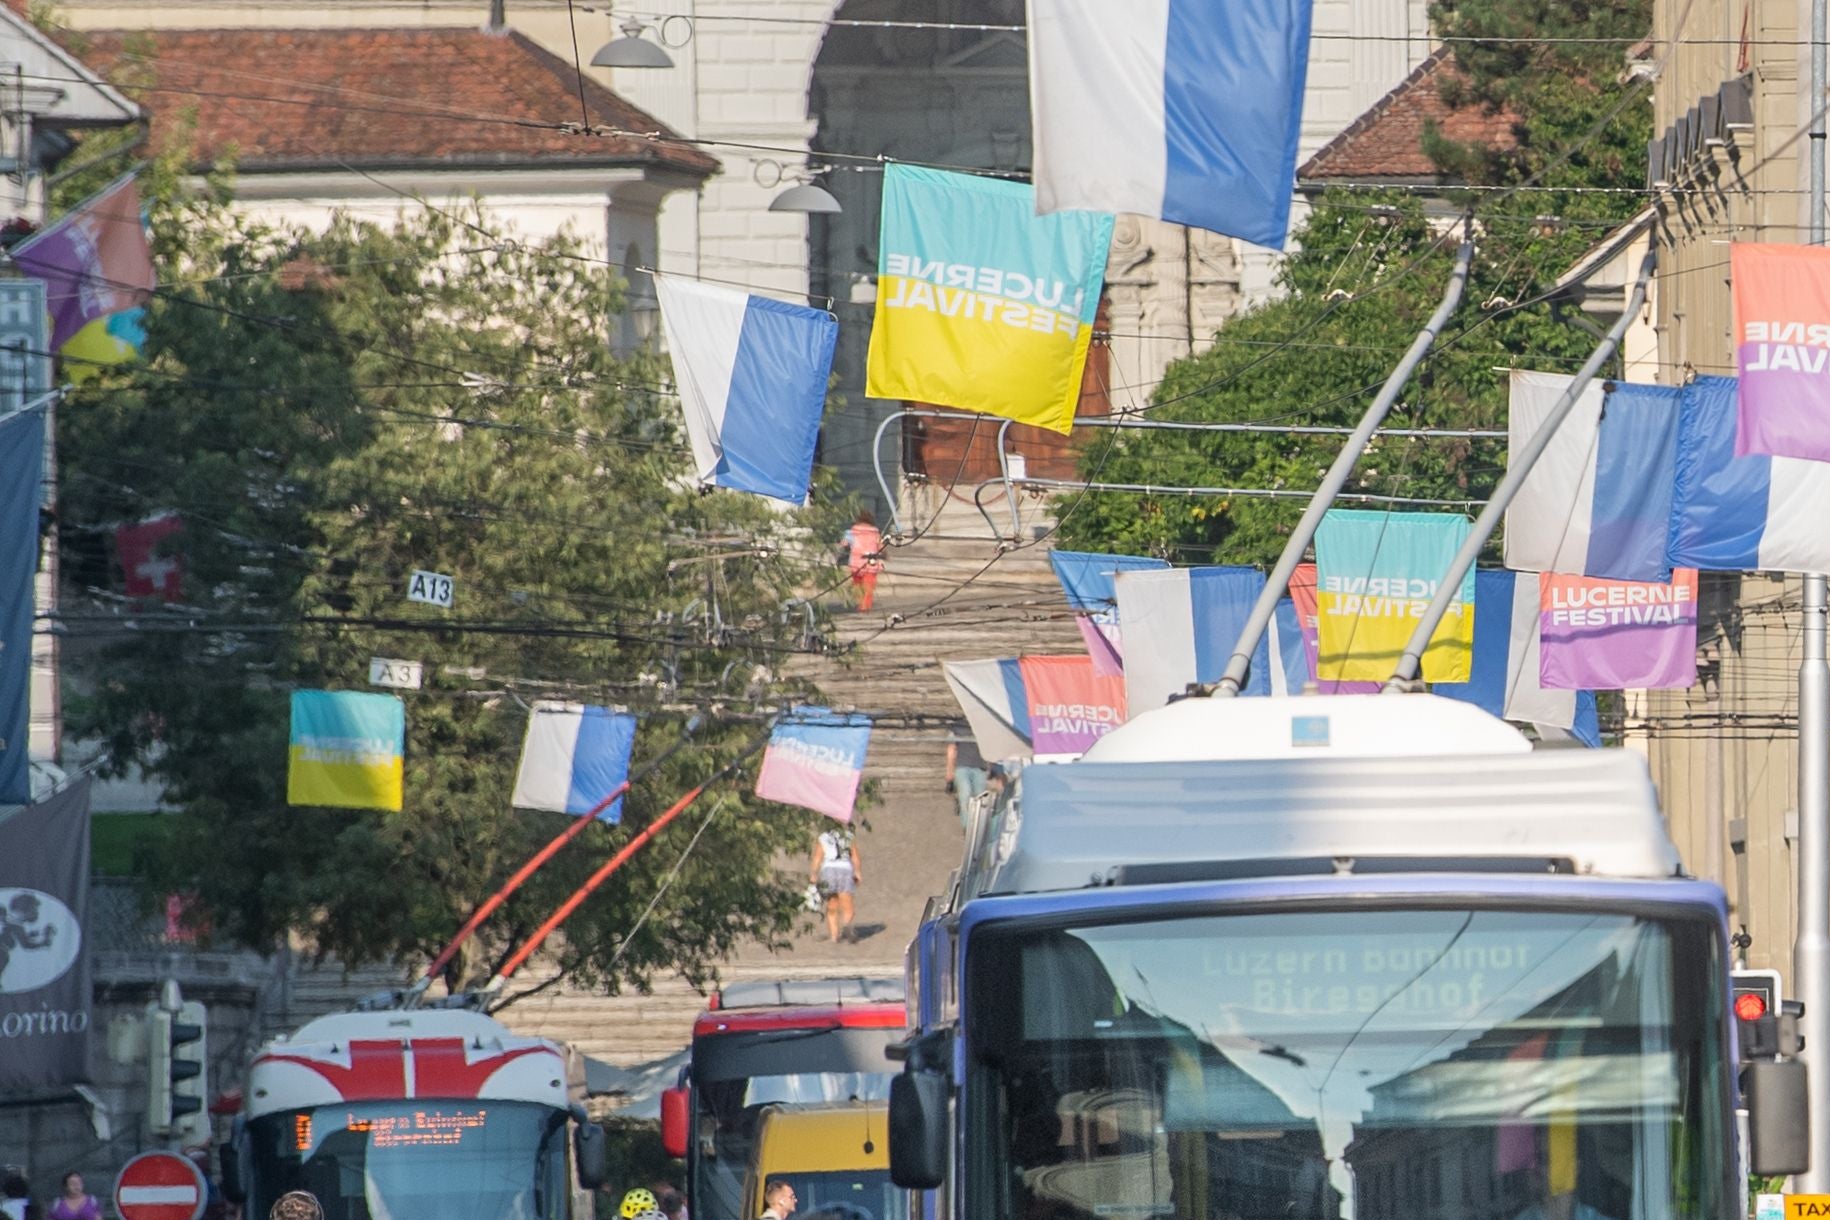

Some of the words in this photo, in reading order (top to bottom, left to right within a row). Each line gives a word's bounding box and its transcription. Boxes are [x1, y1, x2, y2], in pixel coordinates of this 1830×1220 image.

[412, 574, 451, 602] A13
[1552, 585, 1690, 609] LUCERNE
[1553, 603, 1689, 626] FESTIVAL
[0, 1001, 88, 1038] orino
